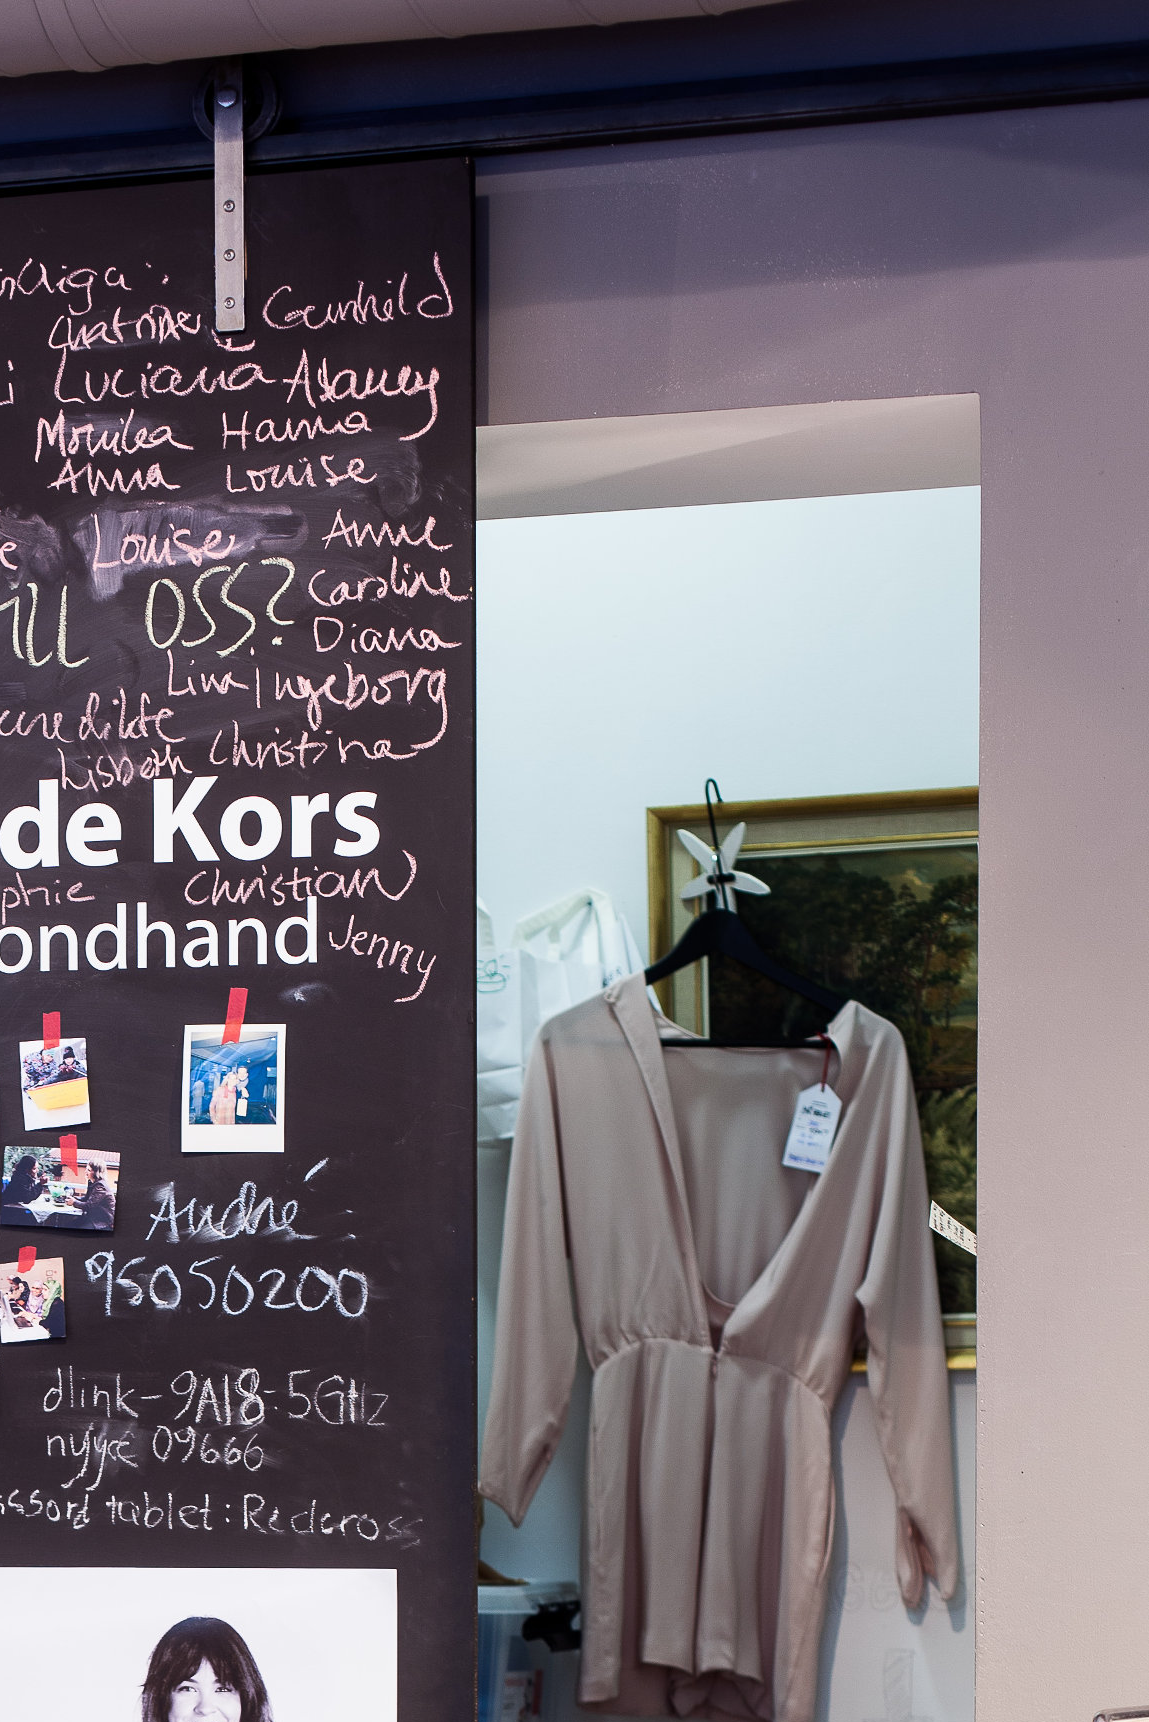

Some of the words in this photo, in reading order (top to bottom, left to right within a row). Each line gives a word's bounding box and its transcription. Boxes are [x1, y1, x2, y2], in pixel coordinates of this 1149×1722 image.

[92, 513, 237, 570] Louise
[313, 616, 462, 654] Diana
[152, 775, 381, 864] Kors
[329, 914, 437, 1003] Jenny
